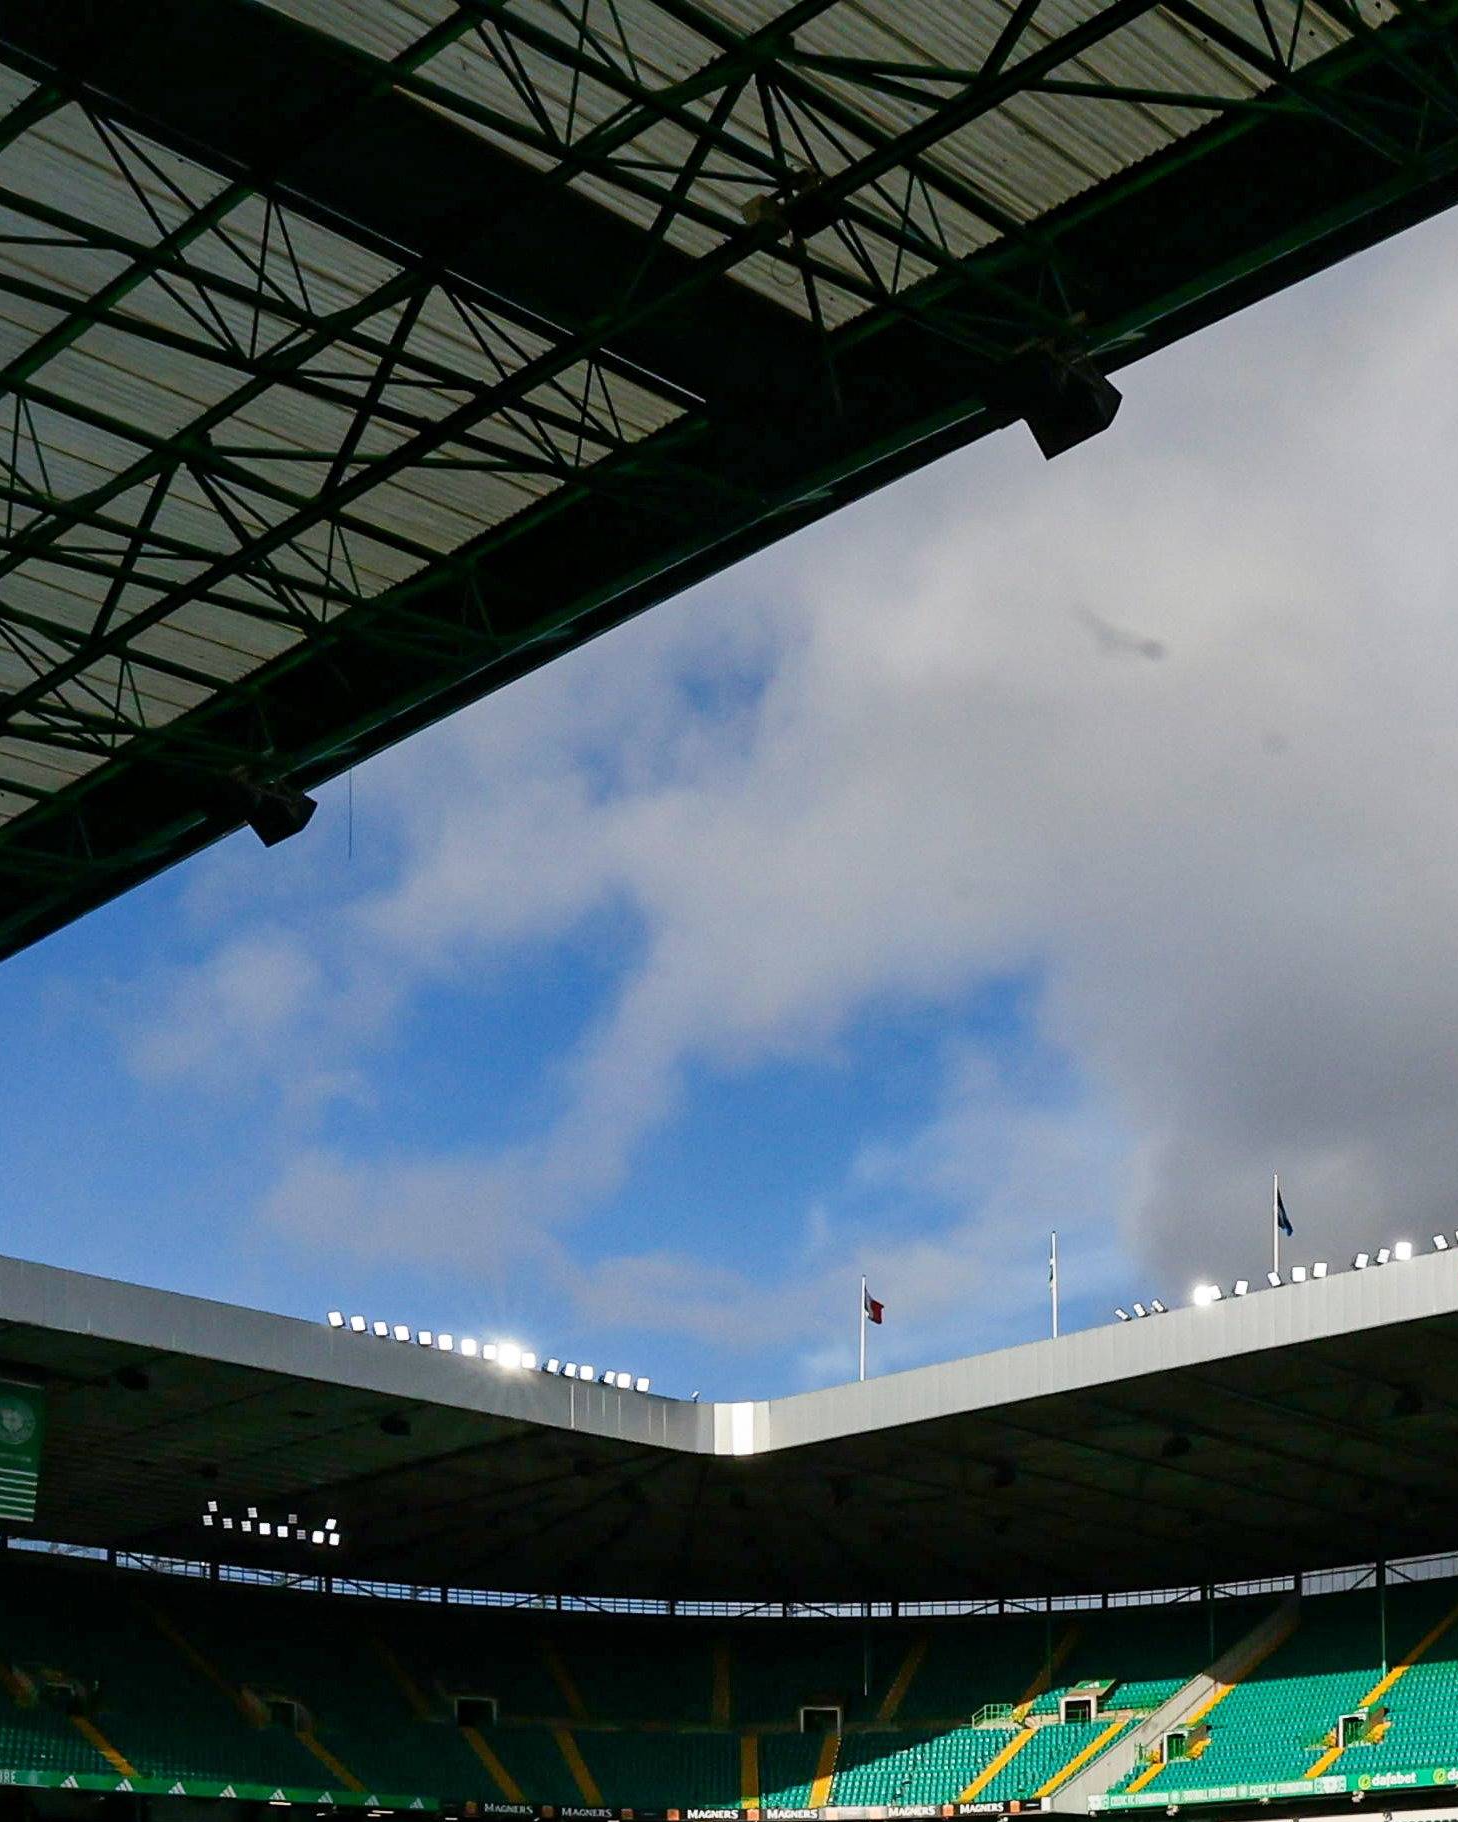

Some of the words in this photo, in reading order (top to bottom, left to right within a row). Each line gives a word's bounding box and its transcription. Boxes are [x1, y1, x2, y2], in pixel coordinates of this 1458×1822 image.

[1372, 1771, 1416, 1787] dafabet
[484, 1803, 533, 1815] MAGNERS
[561, 1806, 613, 1818] MAGNERS
[687, 1808, 739, 1820] MAGNERS
[766, 1808, 818, 1820] MAGNERS
[888, 1805, 935, 1818] MAGNERS
[959, 1802, 1004, 1815] MAGNERS
